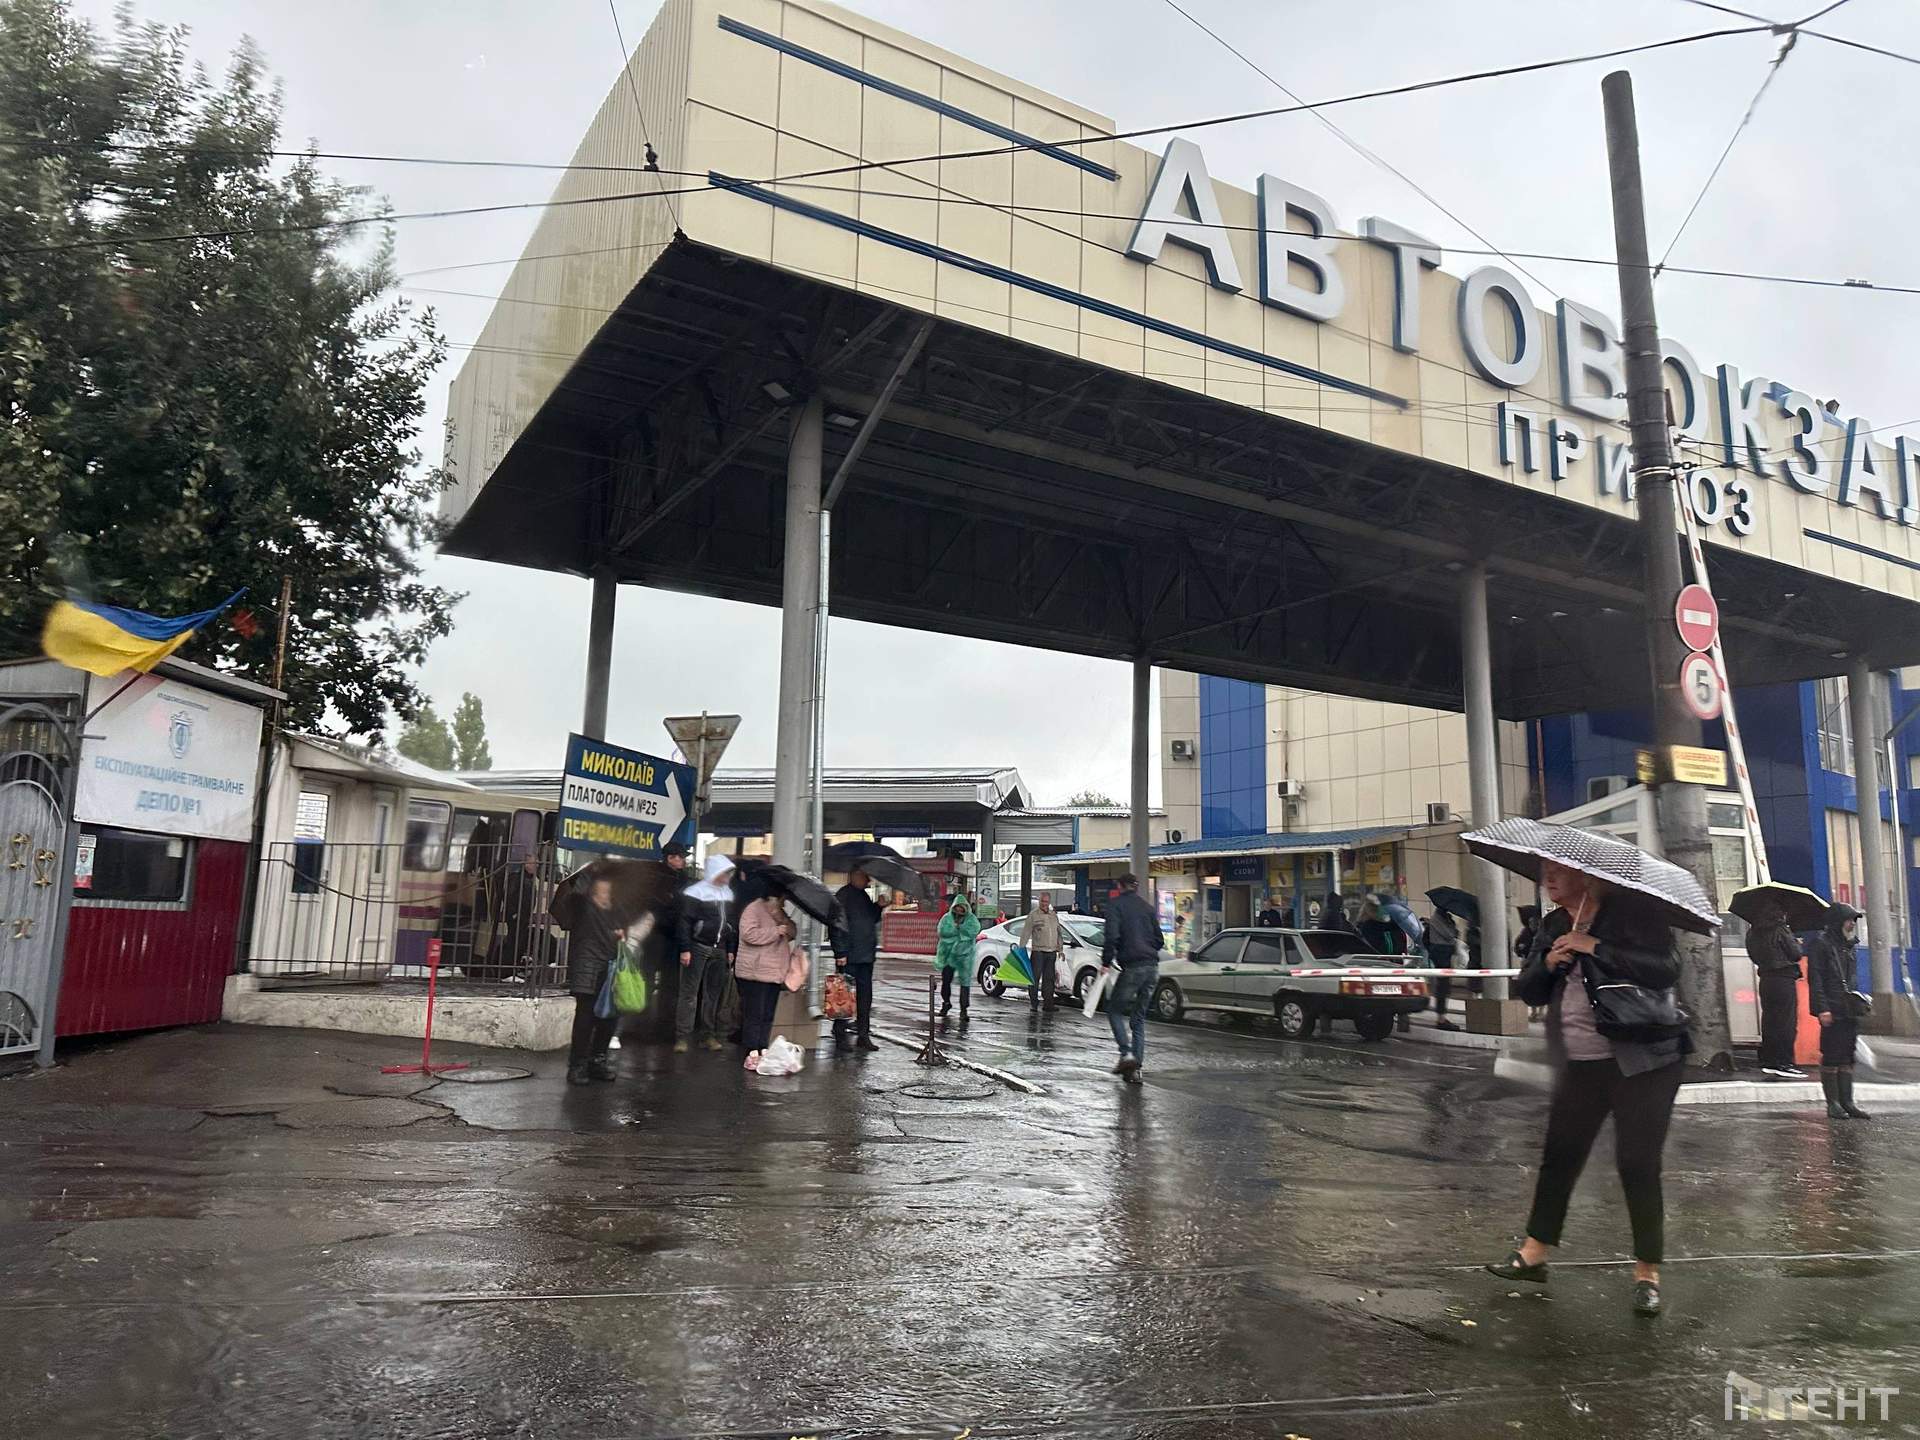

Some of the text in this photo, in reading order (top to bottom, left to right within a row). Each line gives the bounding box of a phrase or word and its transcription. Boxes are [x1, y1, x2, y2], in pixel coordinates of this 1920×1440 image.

[1497, 401, 1756, 537] ПРИОЗ
[1695, 669, 1711, 704] 5
[580, 749, 655, 786] МИКОЛАЇВ
[135, 790, 181, 812] ДЕПО
[567, 783, 658, 816] ПЛАТФОРМА №25
[562, 818, 656, 850] ПЕРВОМАЙСЬК
